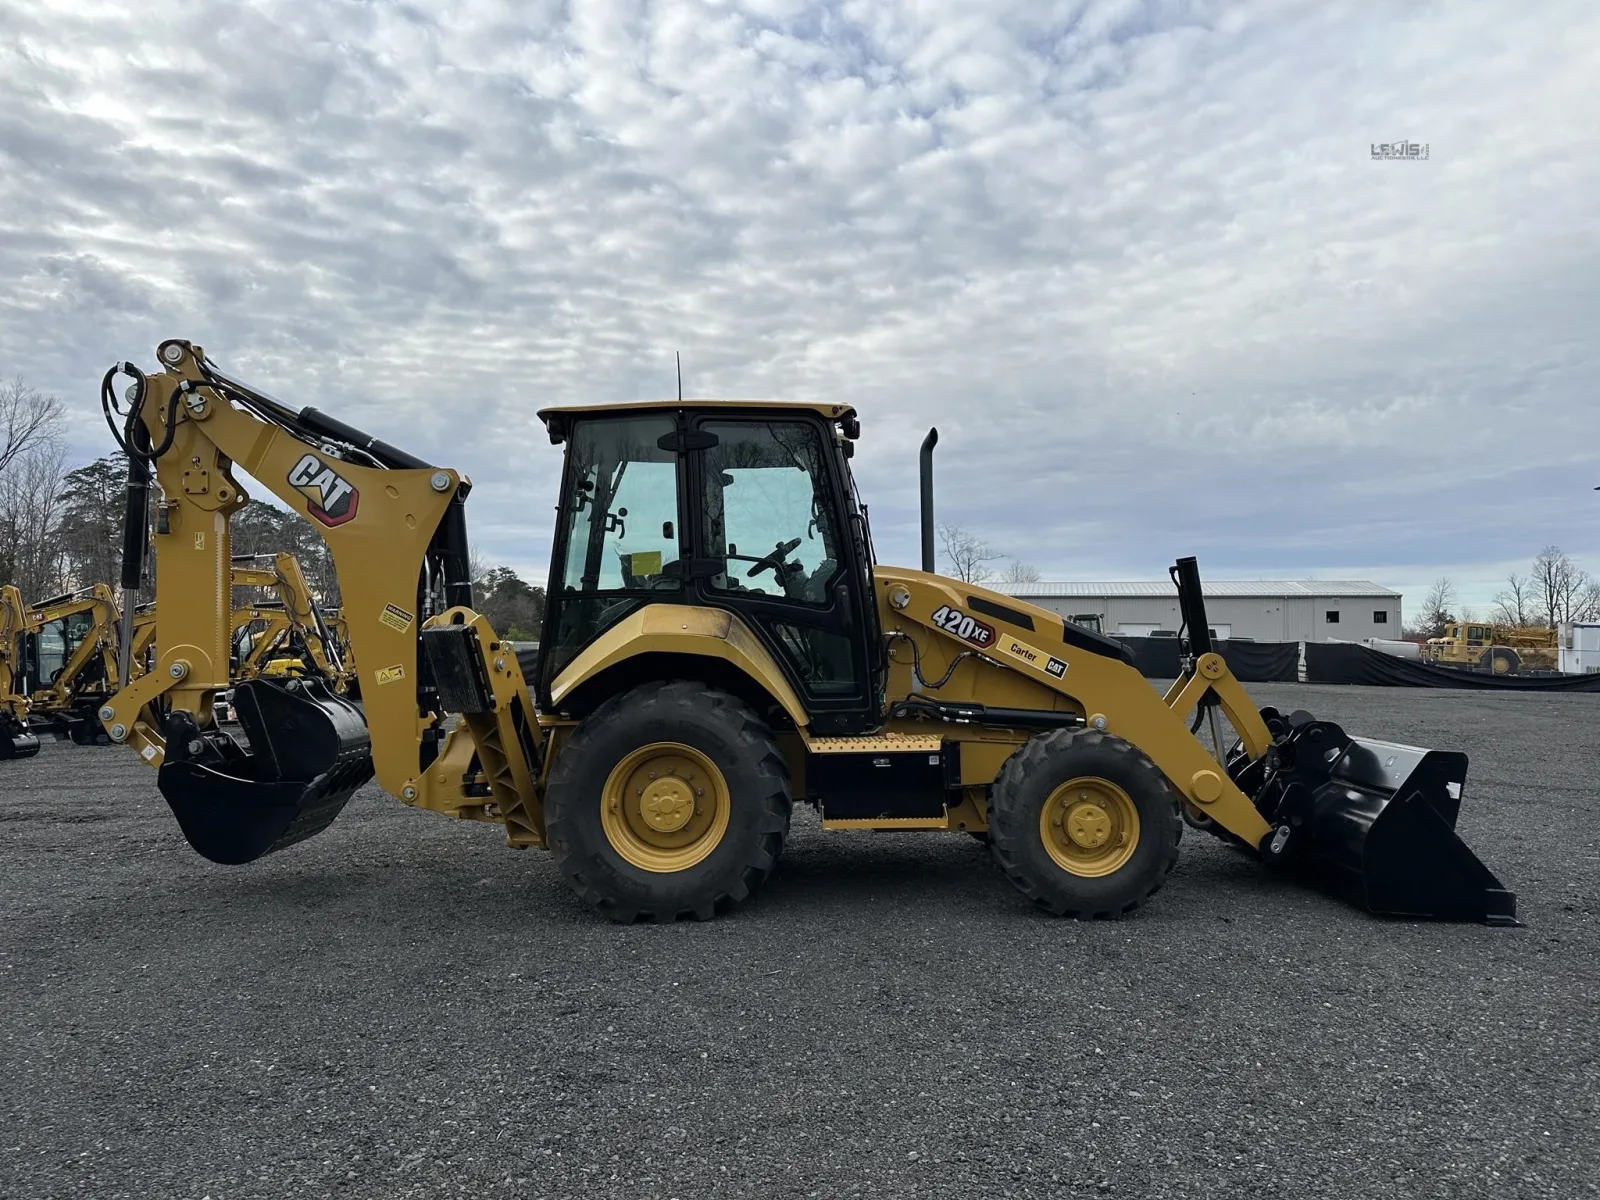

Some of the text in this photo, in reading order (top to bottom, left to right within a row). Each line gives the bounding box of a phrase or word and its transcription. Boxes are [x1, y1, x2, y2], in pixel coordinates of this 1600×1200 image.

[288, 454, 354, 512] CAT
[32, 613, 43, 621] CAT
[387, 605, 412, 621] WARNING
[1010, 642, 1064, 674] Carter CAT
